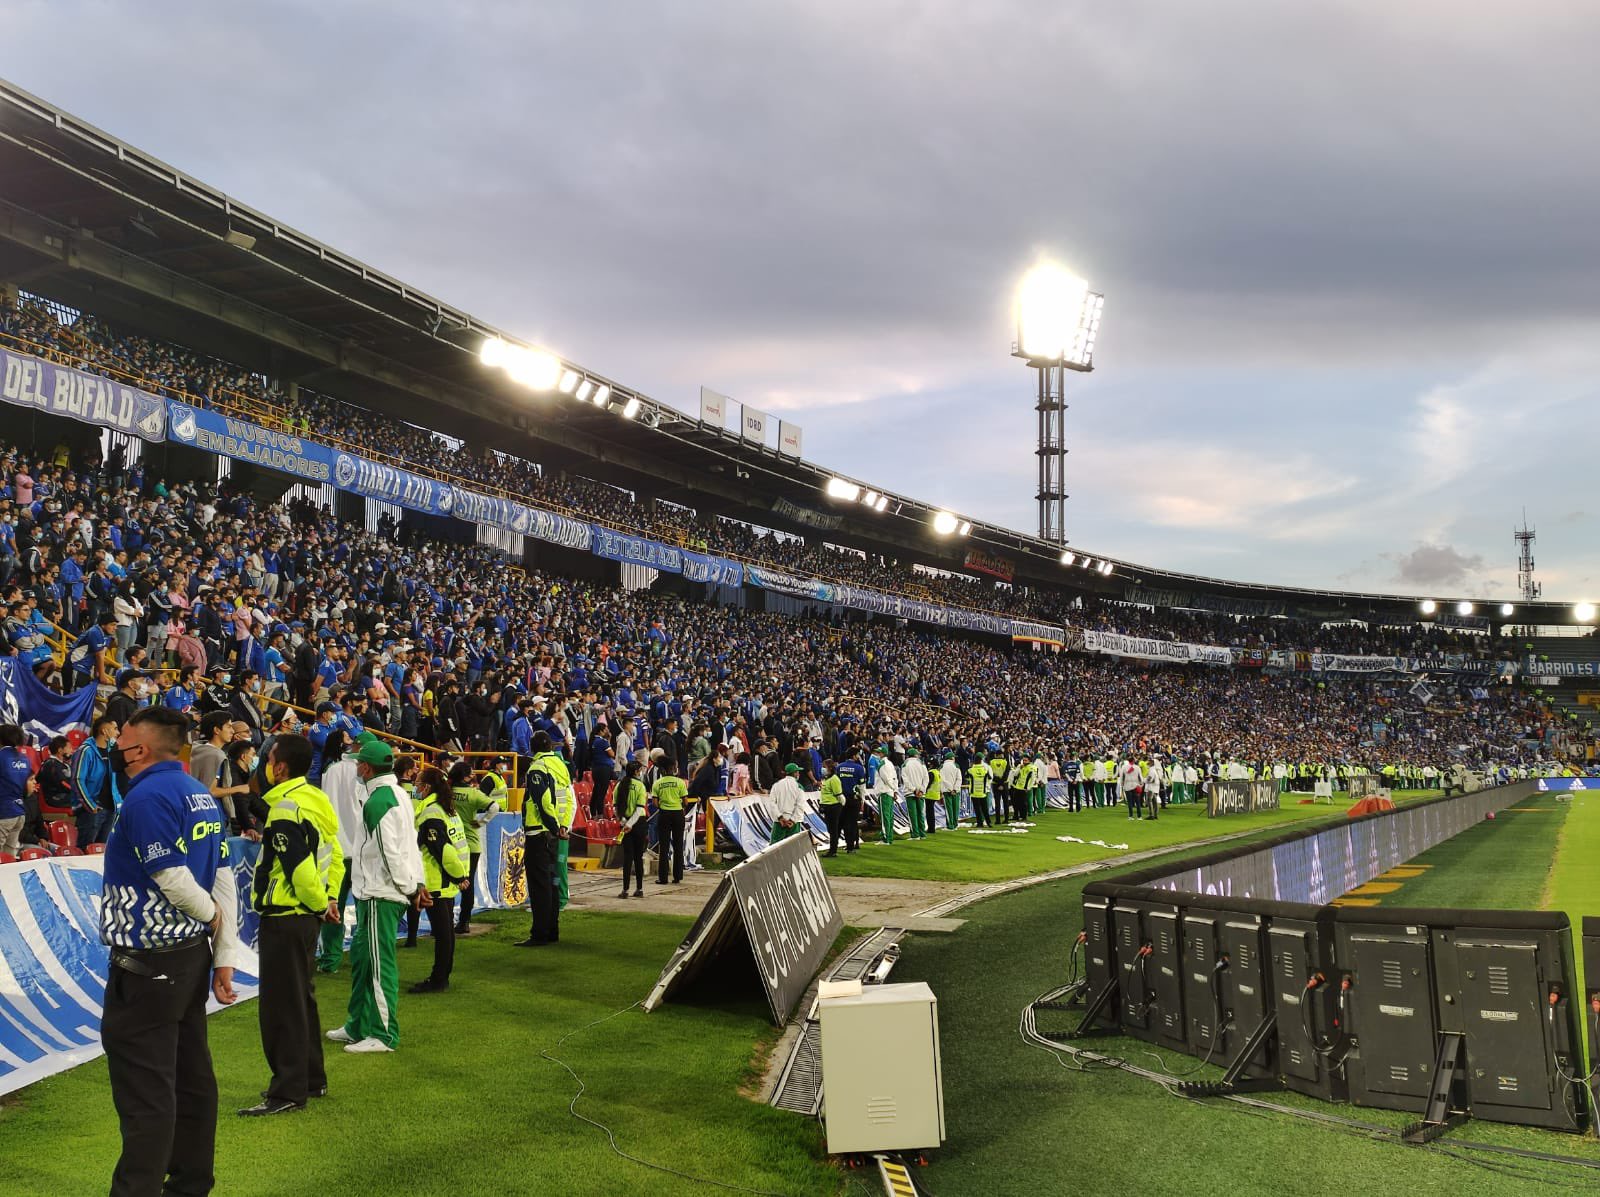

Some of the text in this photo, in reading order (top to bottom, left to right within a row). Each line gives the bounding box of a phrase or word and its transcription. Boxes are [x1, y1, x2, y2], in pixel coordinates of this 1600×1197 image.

[3, 355, 48, 403] DEL
[226, 418, 303, 454] NUEVOS
[747, 416, 762, 432] IDRD
[196, 427, 330, 480] EMBAJADORES
[403, 477, 434, 511] AZUL
[451, 485, 509, 531] ESTRELLA
[605, 532, 682, 568] ESTRELLA AZUL
[722, 563, 739, 586] AZUL
[1529, 661, 1593, 676] BARRIO ES
[747, 849, 837, 989] GUAYOS GOLTY
